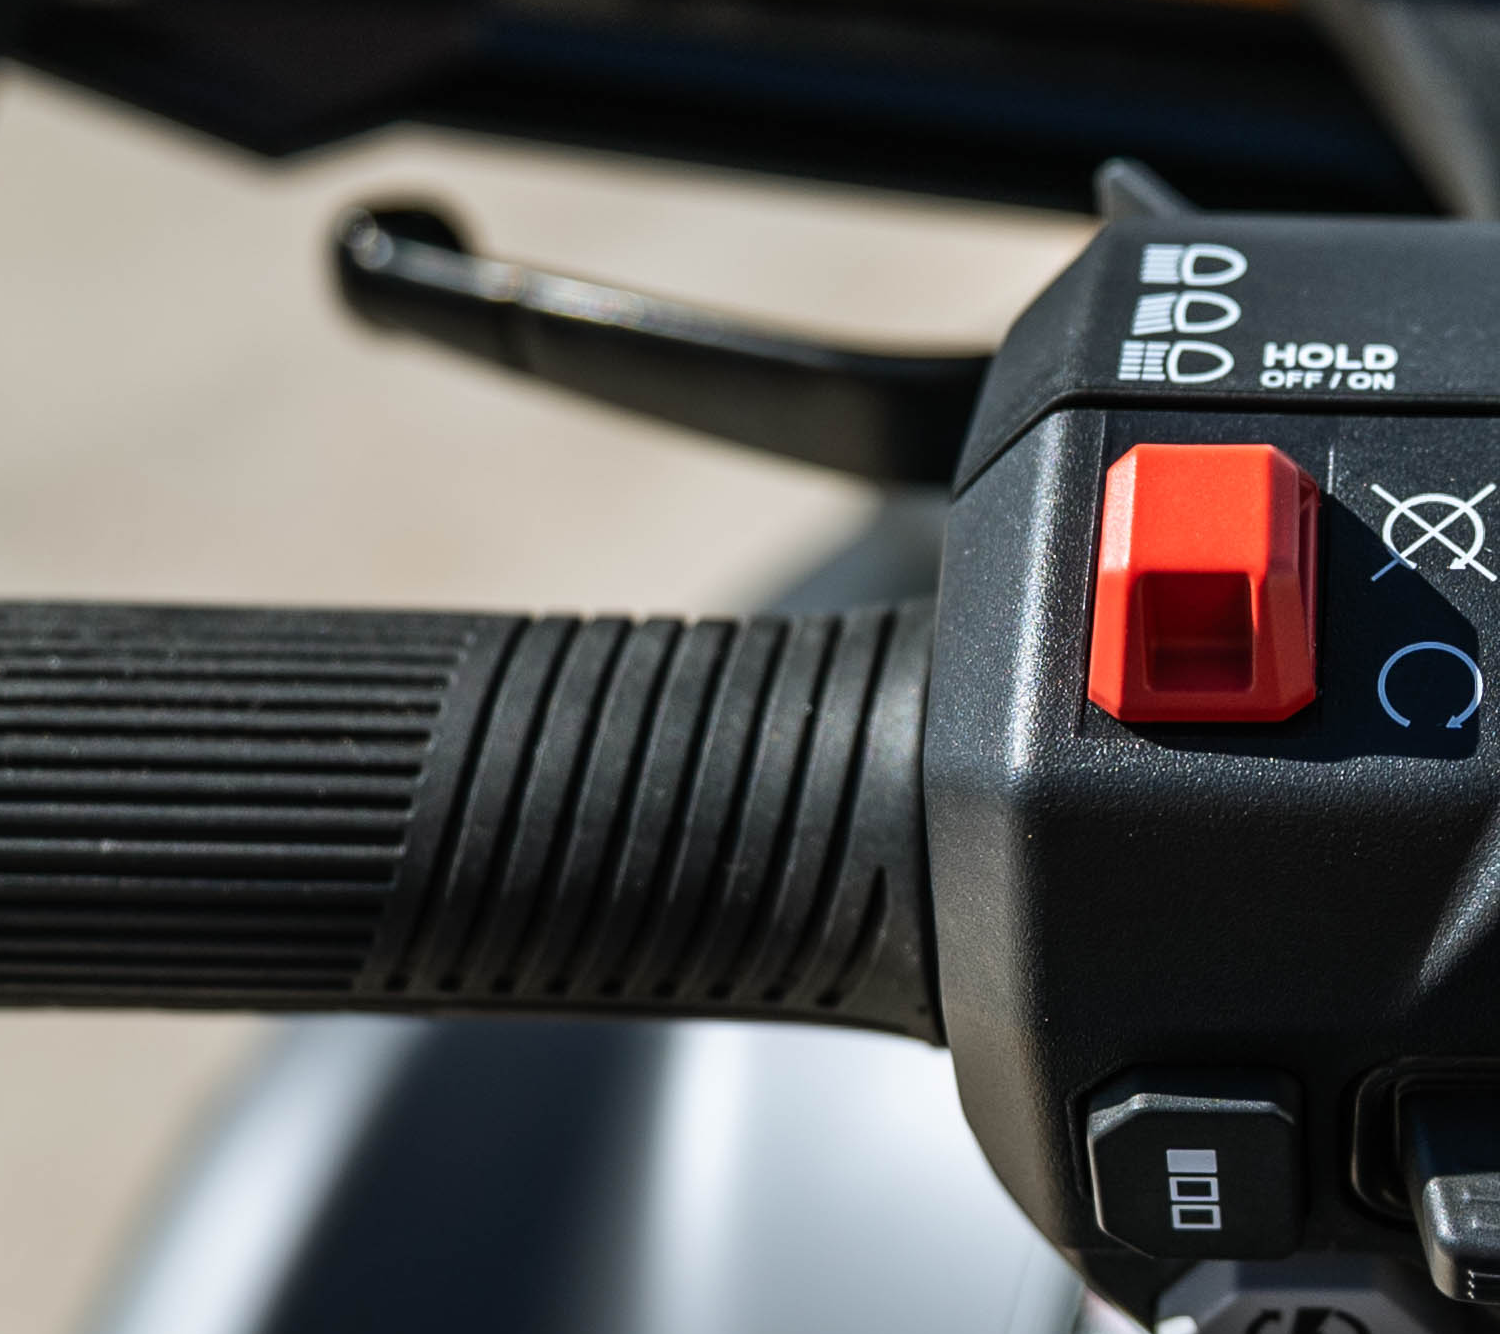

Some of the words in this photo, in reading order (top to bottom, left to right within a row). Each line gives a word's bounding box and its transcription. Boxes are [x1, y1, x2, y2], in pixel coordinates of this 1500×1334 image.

[1263, 341, 1399, 370] HOLD
[1260, 369, 1324, 390] OFF
[1347, 371, 1396, 391] ON
